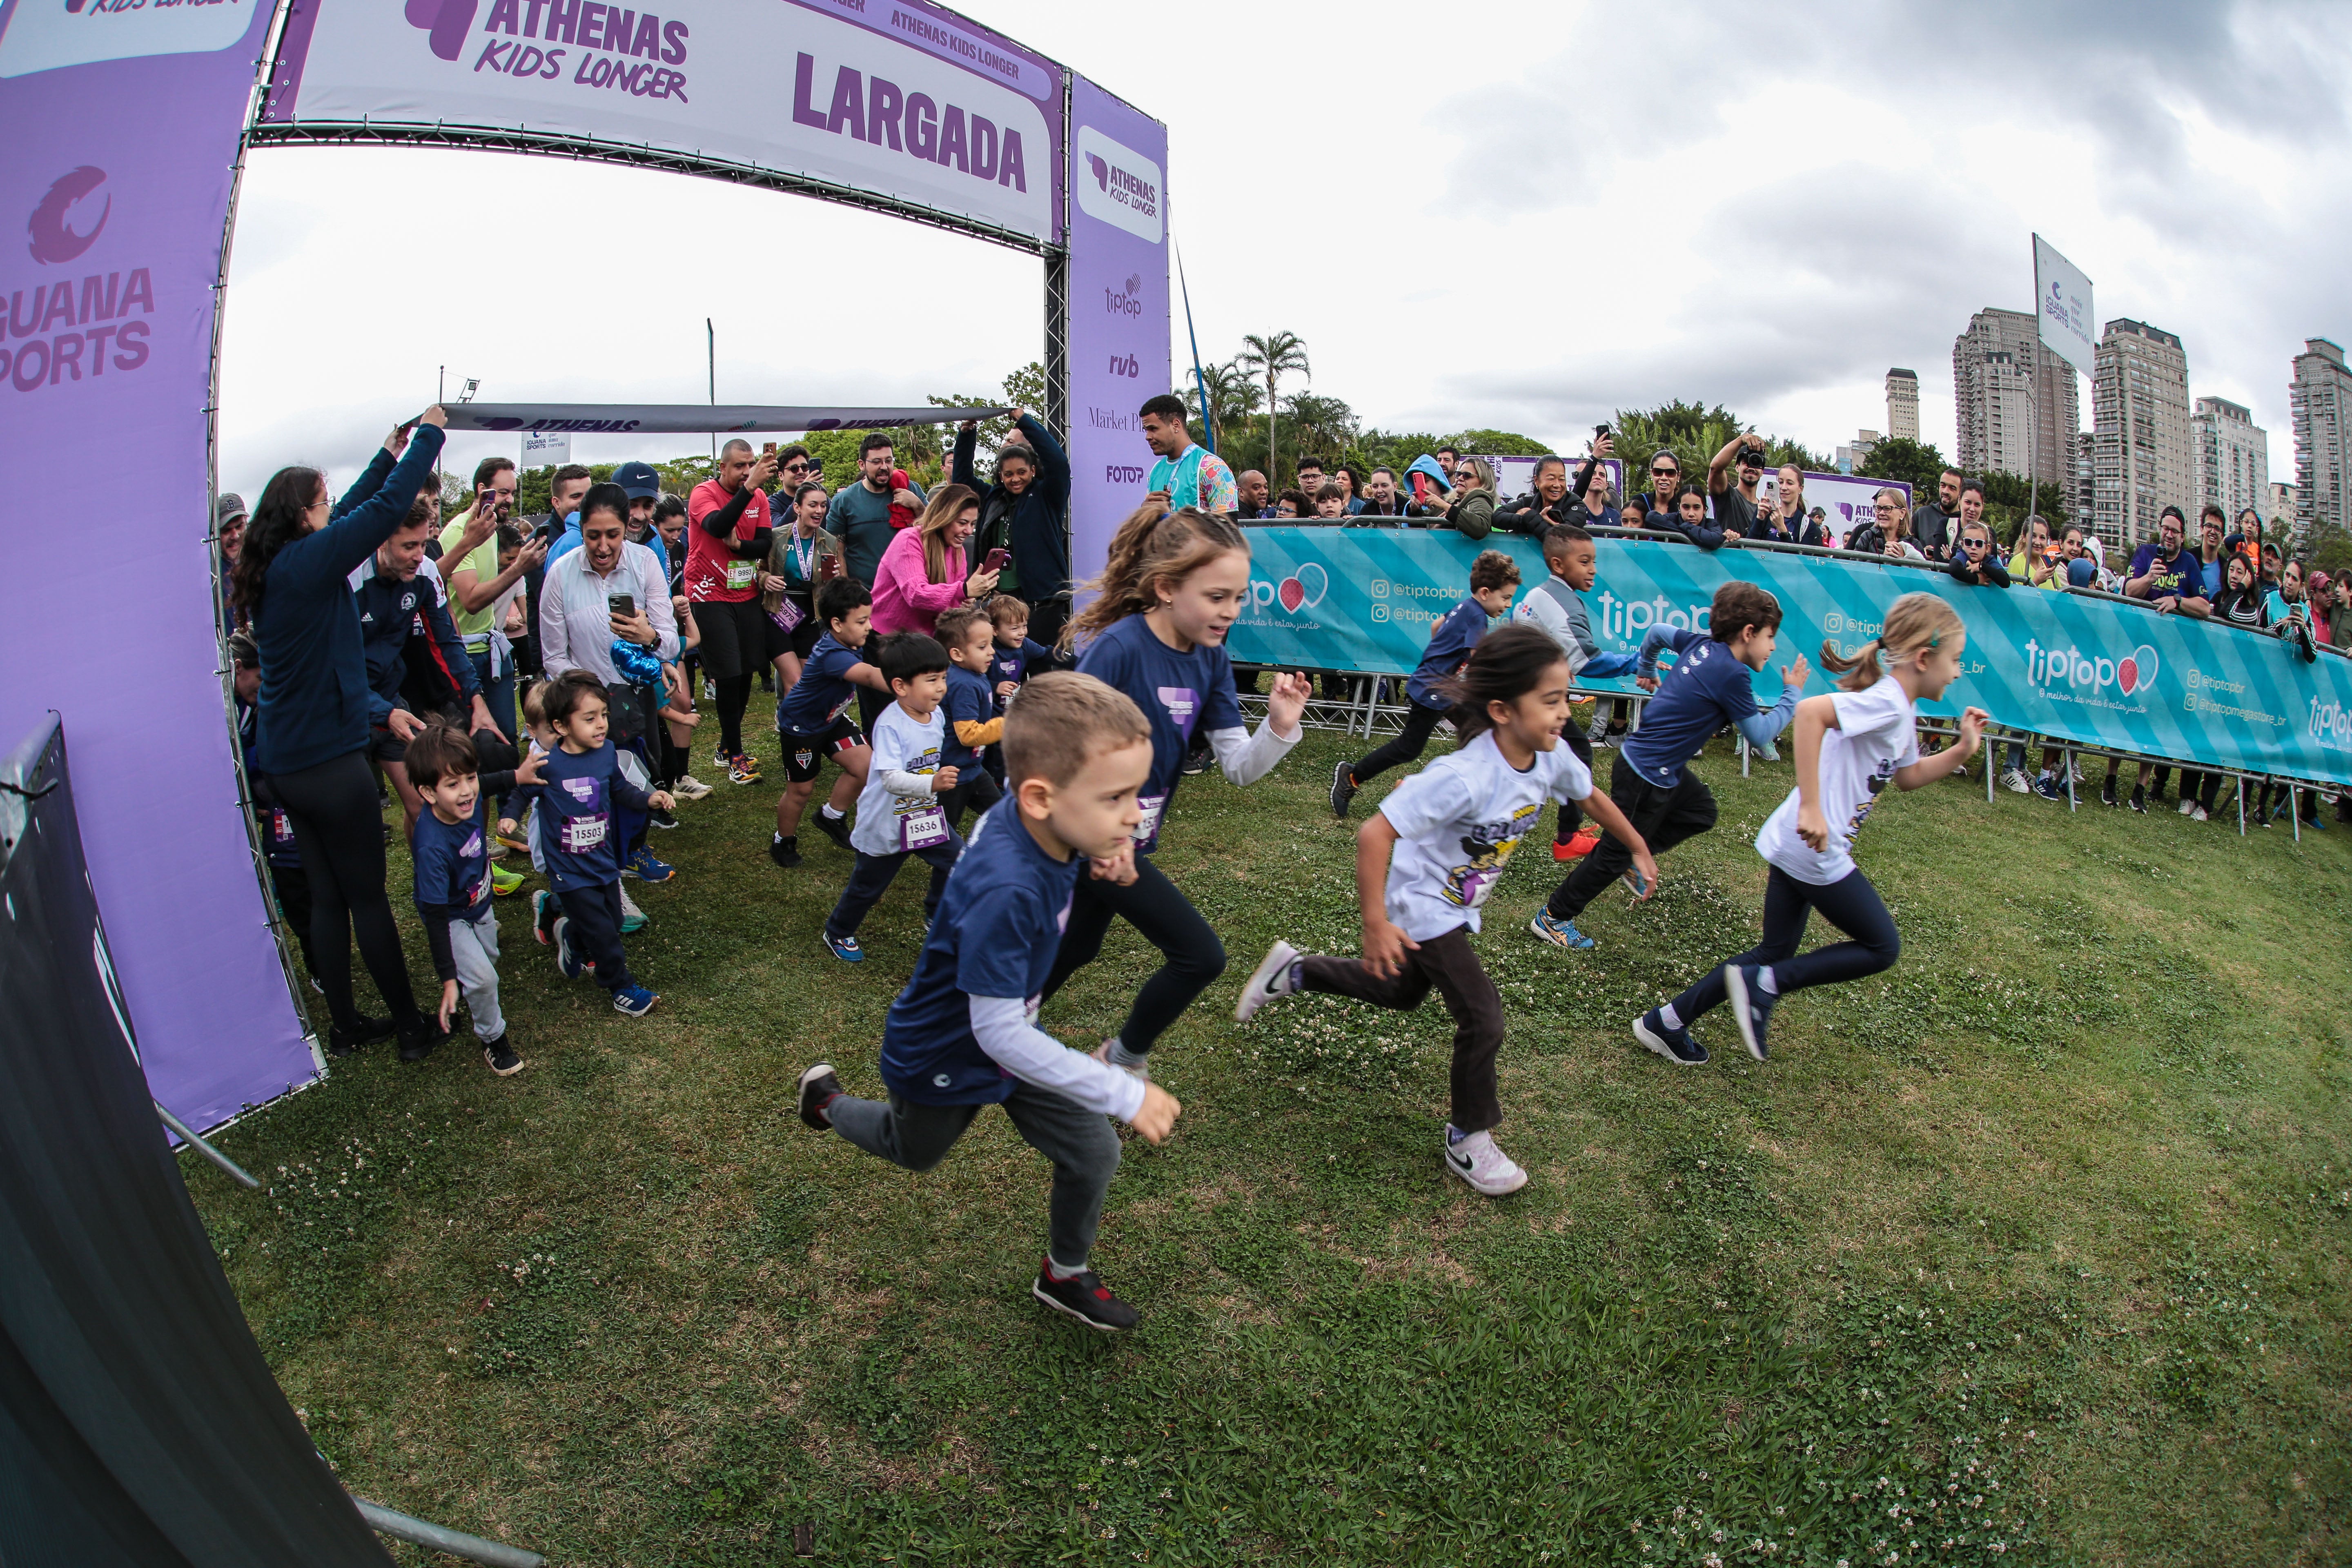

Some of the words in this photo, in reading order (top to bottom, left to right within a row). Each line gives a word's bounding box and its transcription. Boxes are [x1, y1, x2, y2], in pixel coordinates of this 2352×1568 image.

[484, 0, 689, 65] ATHENAS
[891, 9, 948, 47] ATHENAS
[949, 34, 976, 60] KIDS
[978, 47, 1019, 80] LONGER
[474, 39, 567, 80] KIDS
[574, 53, 689, 104] LONGER
[793, 51, 1027, 194] LARGADA
[1110, 165, 1155, 204] ATHENAS
[1109, 186, 1129, 205] KIDS
[1131, 196, 1157, 219] LONGER
[0, 267, 154, 341] UANA
[1105, 287, 1141, 319] tiptop
[2045, 294, 2068, 320] IGUANA
[2070, 295, 2082, 309] mais
[2070, 305, 2080, 317] que
[2045, 304, 2069, 329] SPORTS
[2071, 315, 2082, 329] uma
[2070, 326, 2089, 345] corrida
[1109, 353, 1139, 378] rvb
[523, 419, 640, 432] ATHENAS
[1088, 406, 1128, 431] Market
[1107, 466, 1144, 484] FOTOP
[1394, 583, 1463, 600] @tiptopbr
[1248, 618, 1266, 626] vida
[1268, 618, 1273, 626] é
[1275, 619, 1296, 628] estar
[1296, 620, 1320, 632] junto
[2025, 638, 2115, 695] tiptop
[2202, 675, 2245, 694] @tiptopbr
[2047, 691, 2073, 702] melhor
[2074, 694, 2085, 704] da
[2085, 696, 2103, 706] vida
[2103, 699, 2108, 708] é
[2109, 701, 2127, 711] estar
[2125, 704, 2147, 715] junto
[2198, 698, 2287, 726] @tiptopmegastore_br
[575, 827, 601, 839] 15503
[909, 821, 937, 834] 15636
